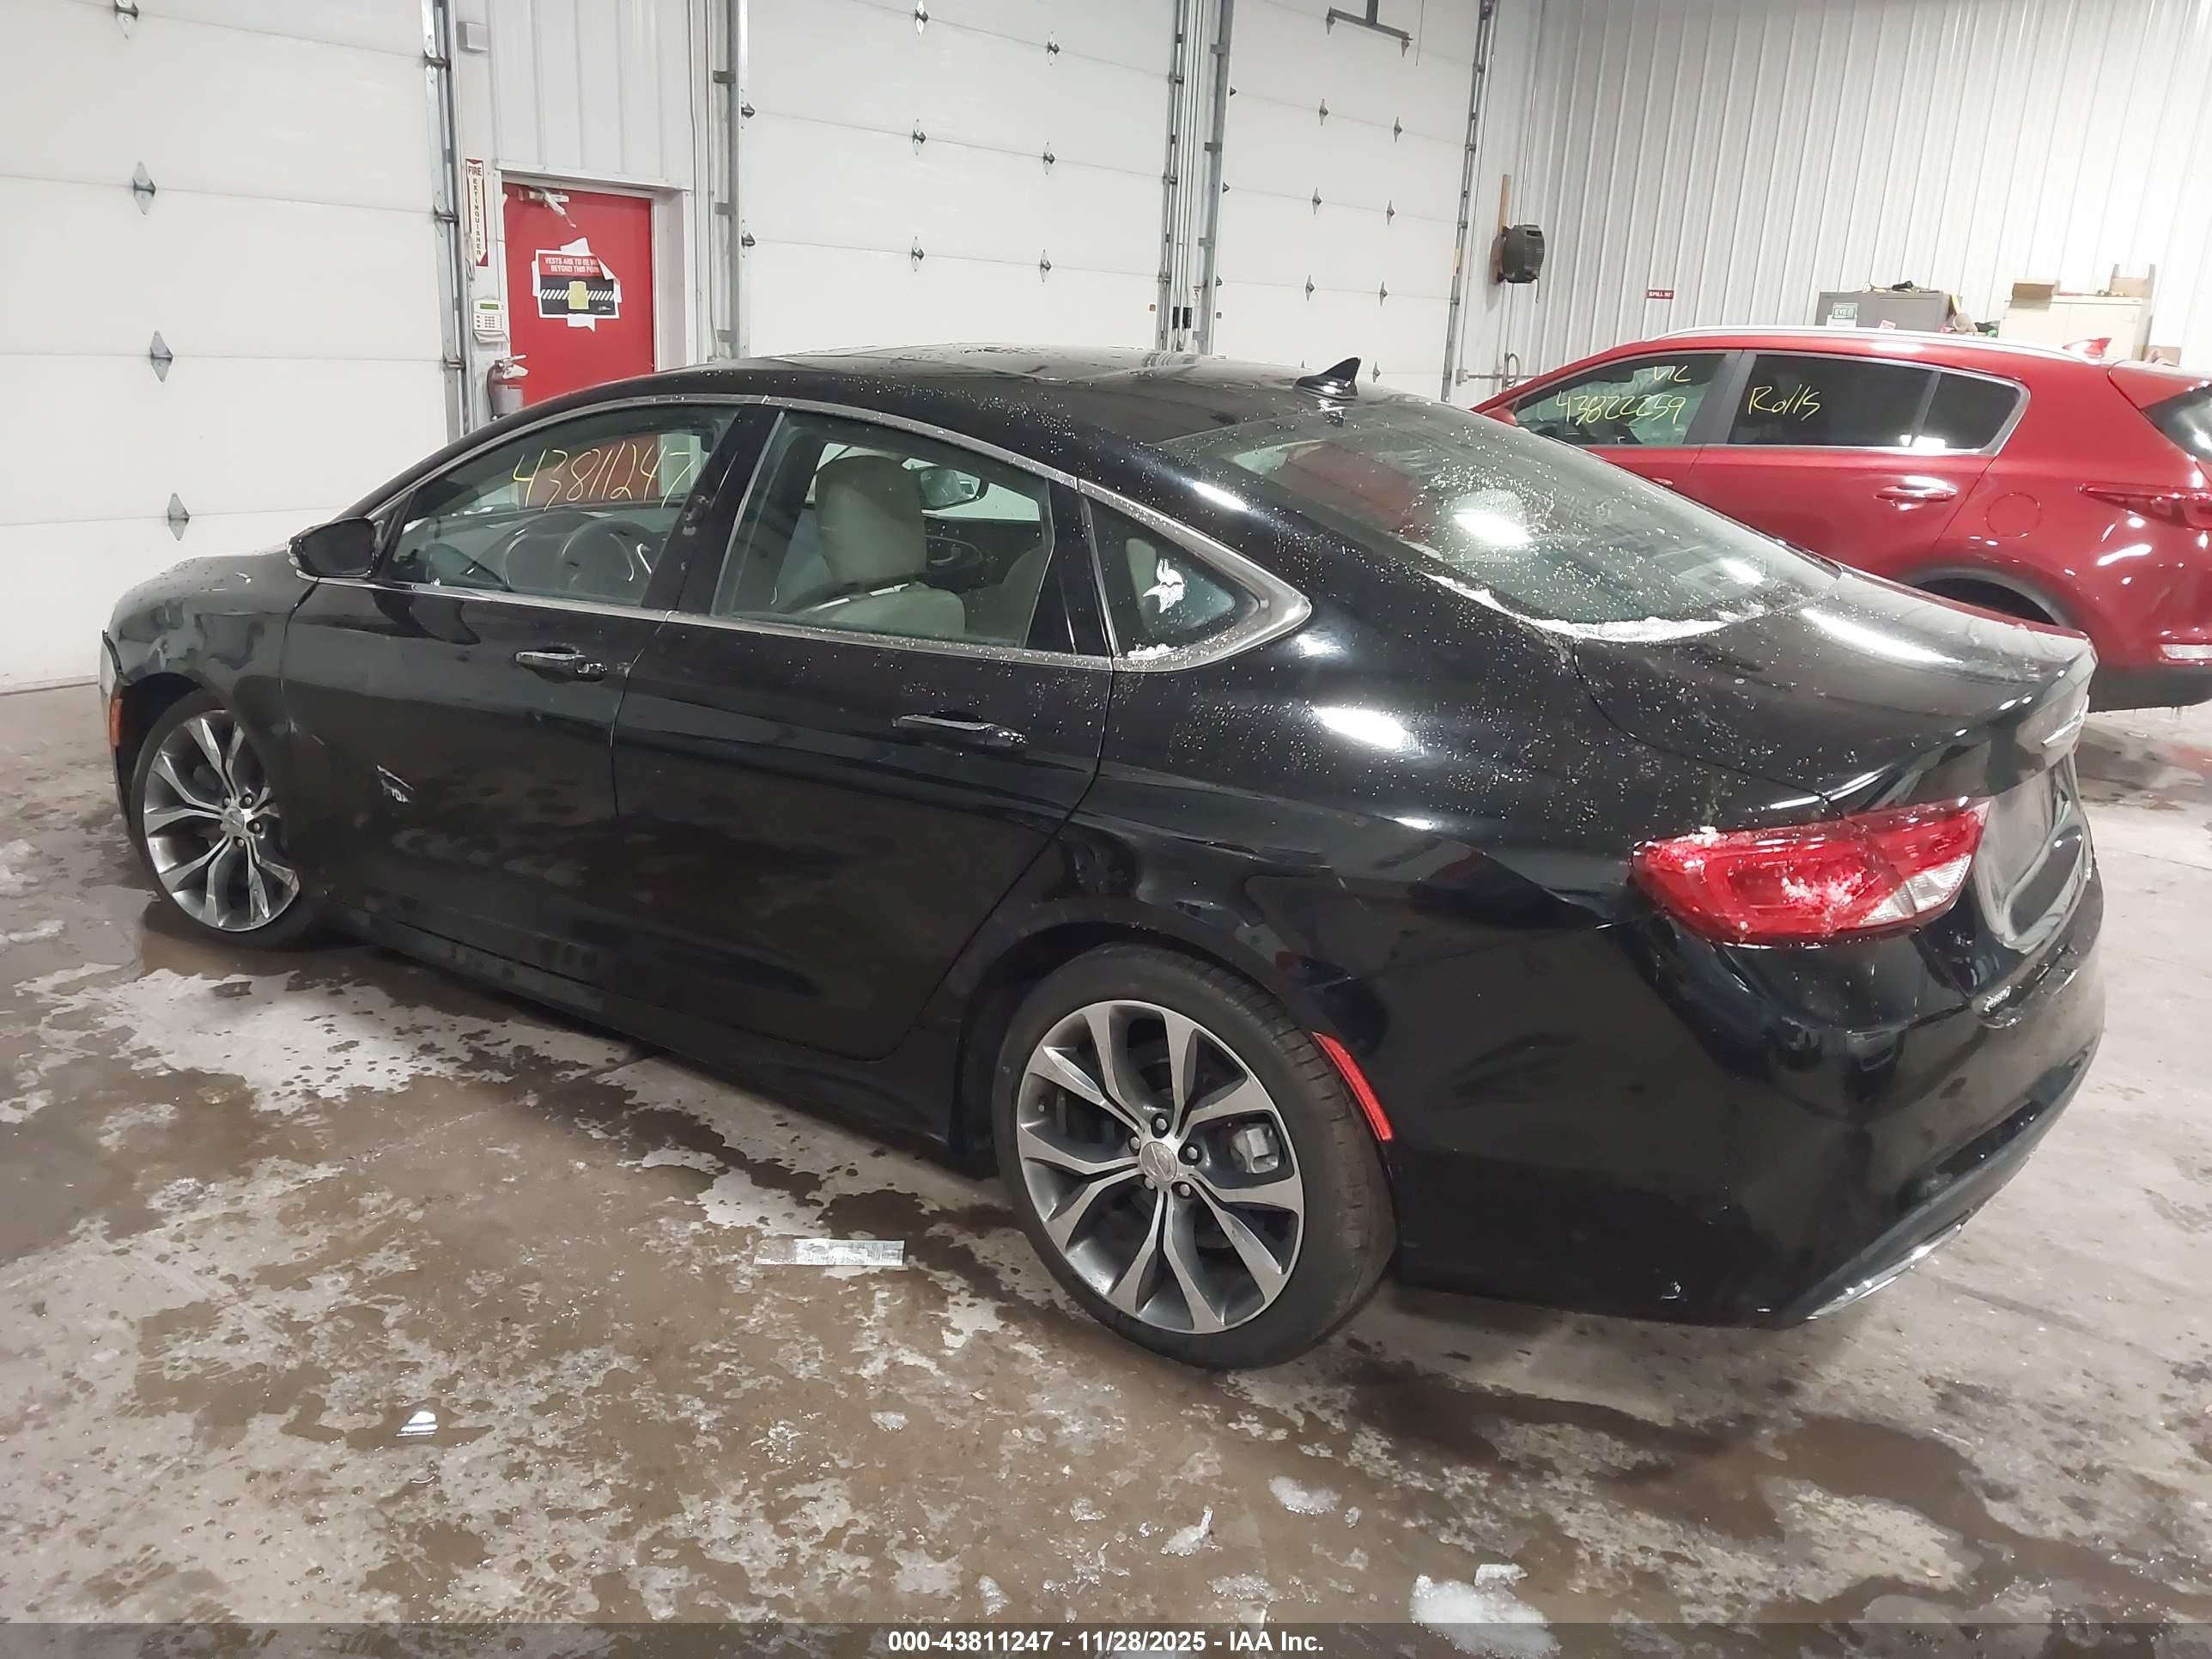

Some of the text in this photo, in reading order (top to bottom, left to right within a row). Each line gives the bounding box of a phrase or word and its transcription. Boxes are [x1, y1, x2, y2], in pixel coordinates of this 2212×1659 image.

[468, 166, 482, 176] FIRE
[1556, 390, 1686, 426] 43822259
[1748, 384, 1820, 421] Rolls
[513, 441, 697, 512] 43811247
